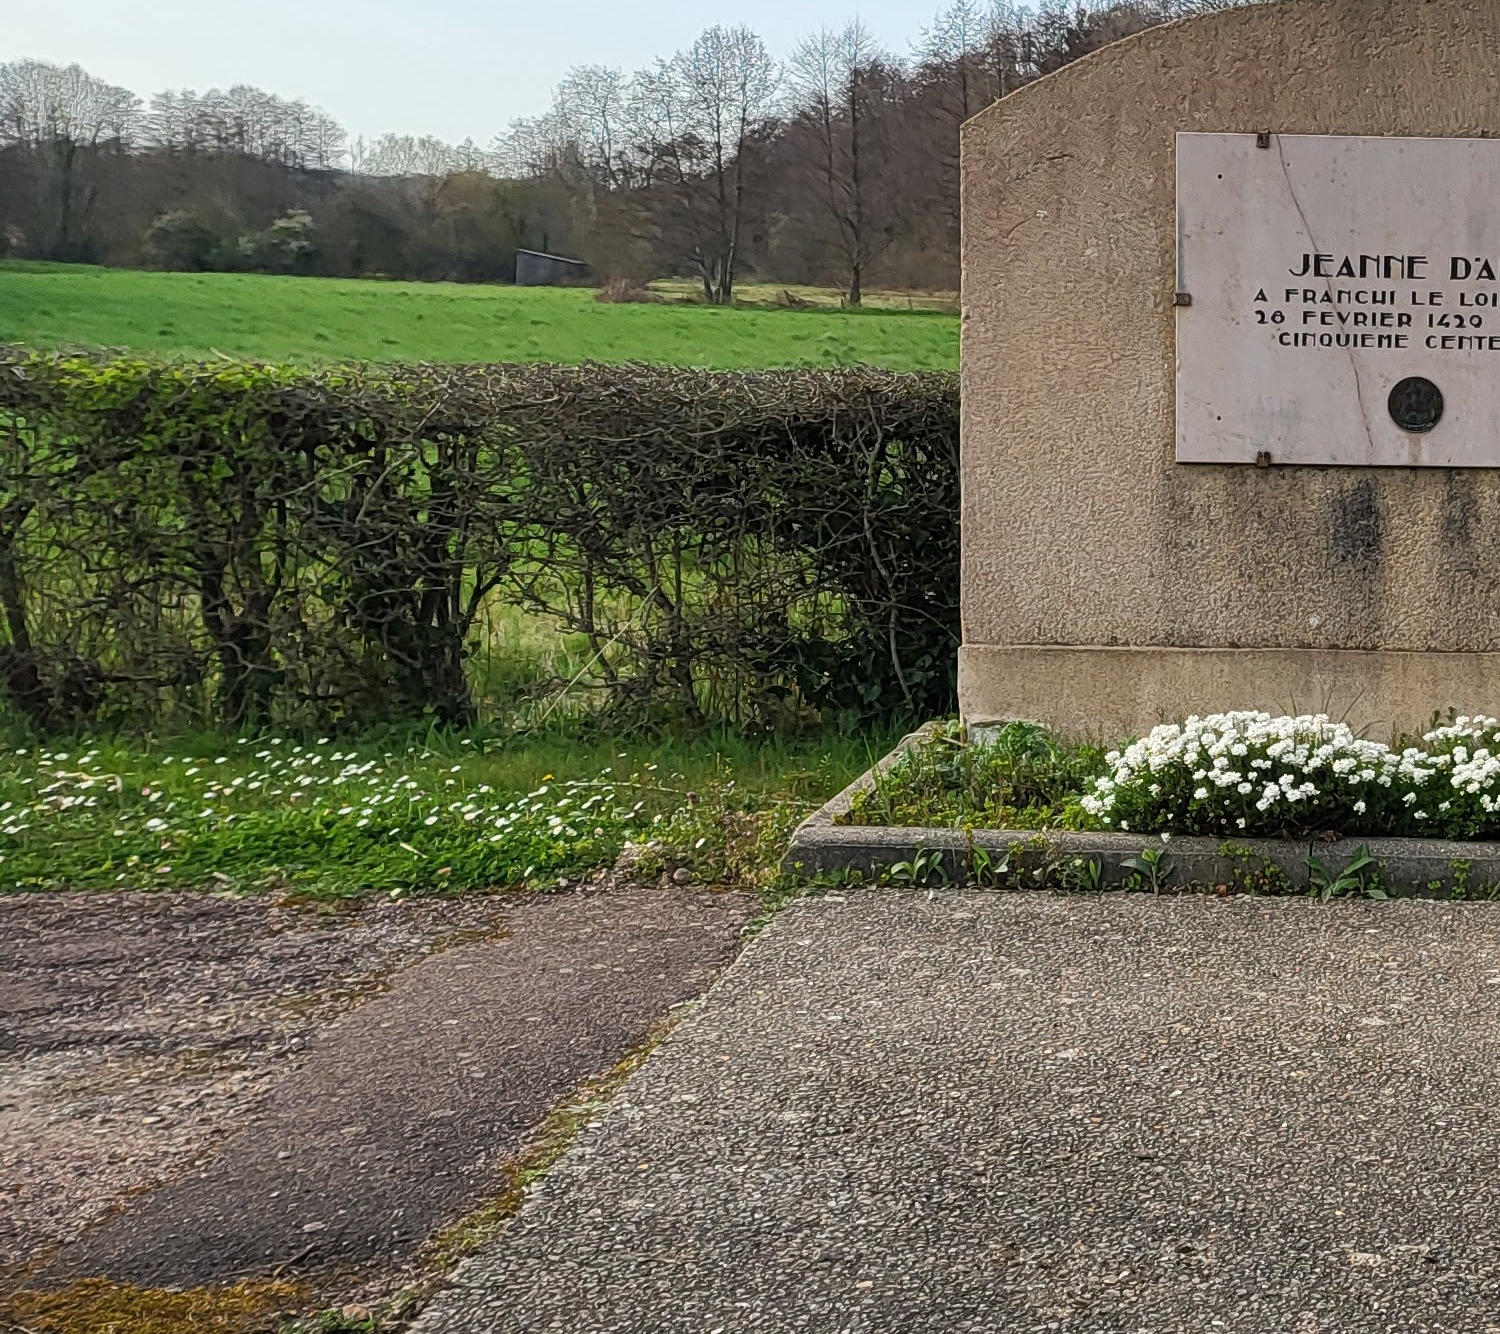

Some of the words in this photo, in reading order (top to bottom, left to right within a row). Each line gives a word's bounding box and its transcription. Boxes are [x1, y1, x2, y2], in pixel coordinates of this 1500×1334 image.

[1288, 253, 1429, 280] JEANNE
[1253, 288, 1269, 303] A
[1284, 288, 1396, 306] FRANCHI
[1411, 290, 1444, 307] LE
[1302, 310, 1413, 328] FEVRIER
[1427, 313, 1483, 329] 1429
[1278, 331, 1409, 349] CINQUIEME
